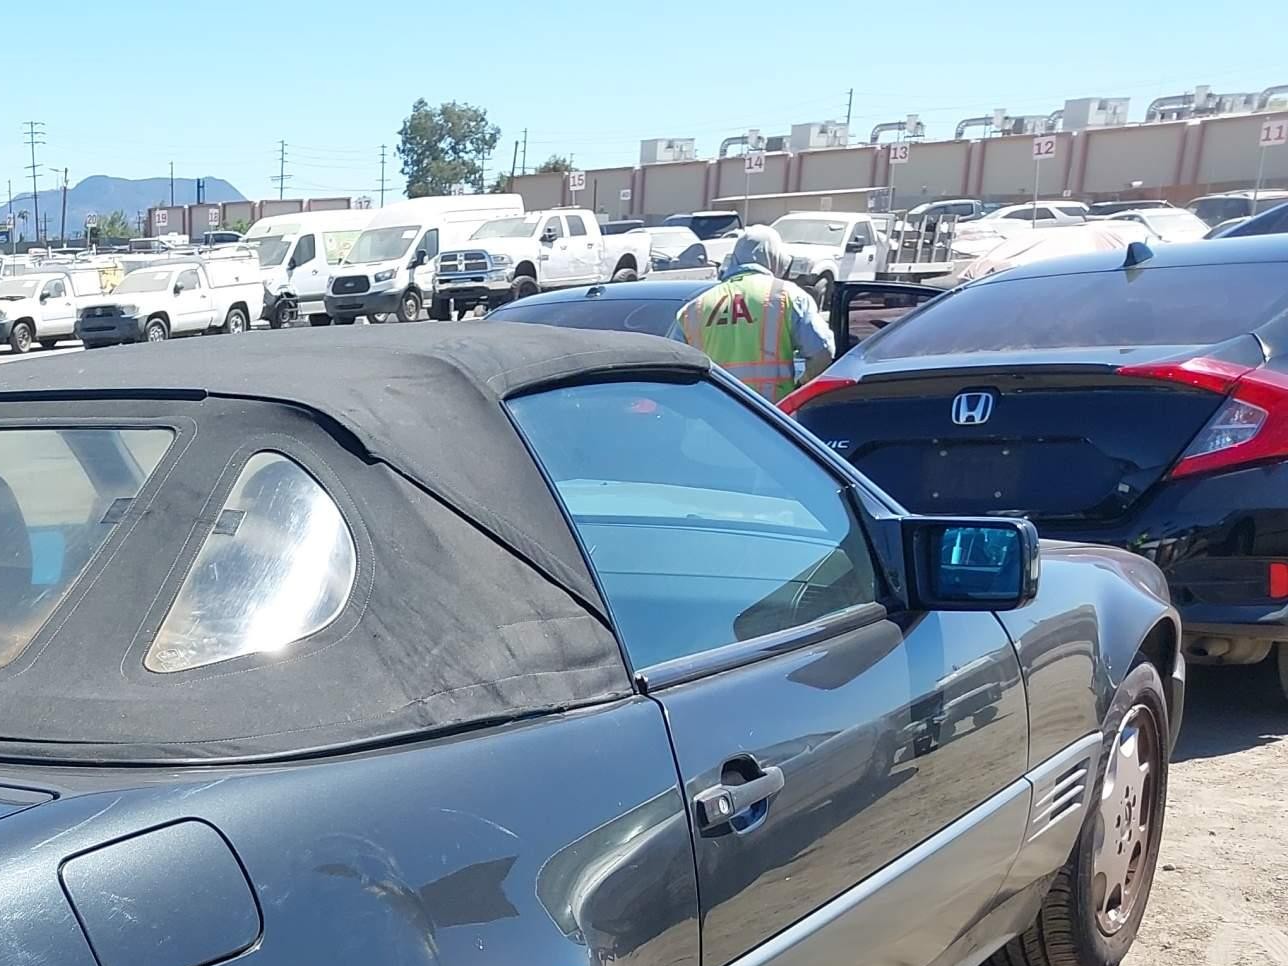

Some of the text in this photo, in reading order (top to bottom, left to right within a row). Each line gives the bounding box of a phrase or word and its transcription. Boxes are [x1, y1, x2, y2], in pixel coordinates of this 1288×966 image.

[1263, 126, 1285, 142] 11
[891, 147, 908, 160] 13
[1034, 141, 1054, 156] 12
[746, 157, 762, 170] 14
[570, 174, 584, 186] 15
[87, 214, 97, 225] 20
[156, 213, 167, 224] 19
